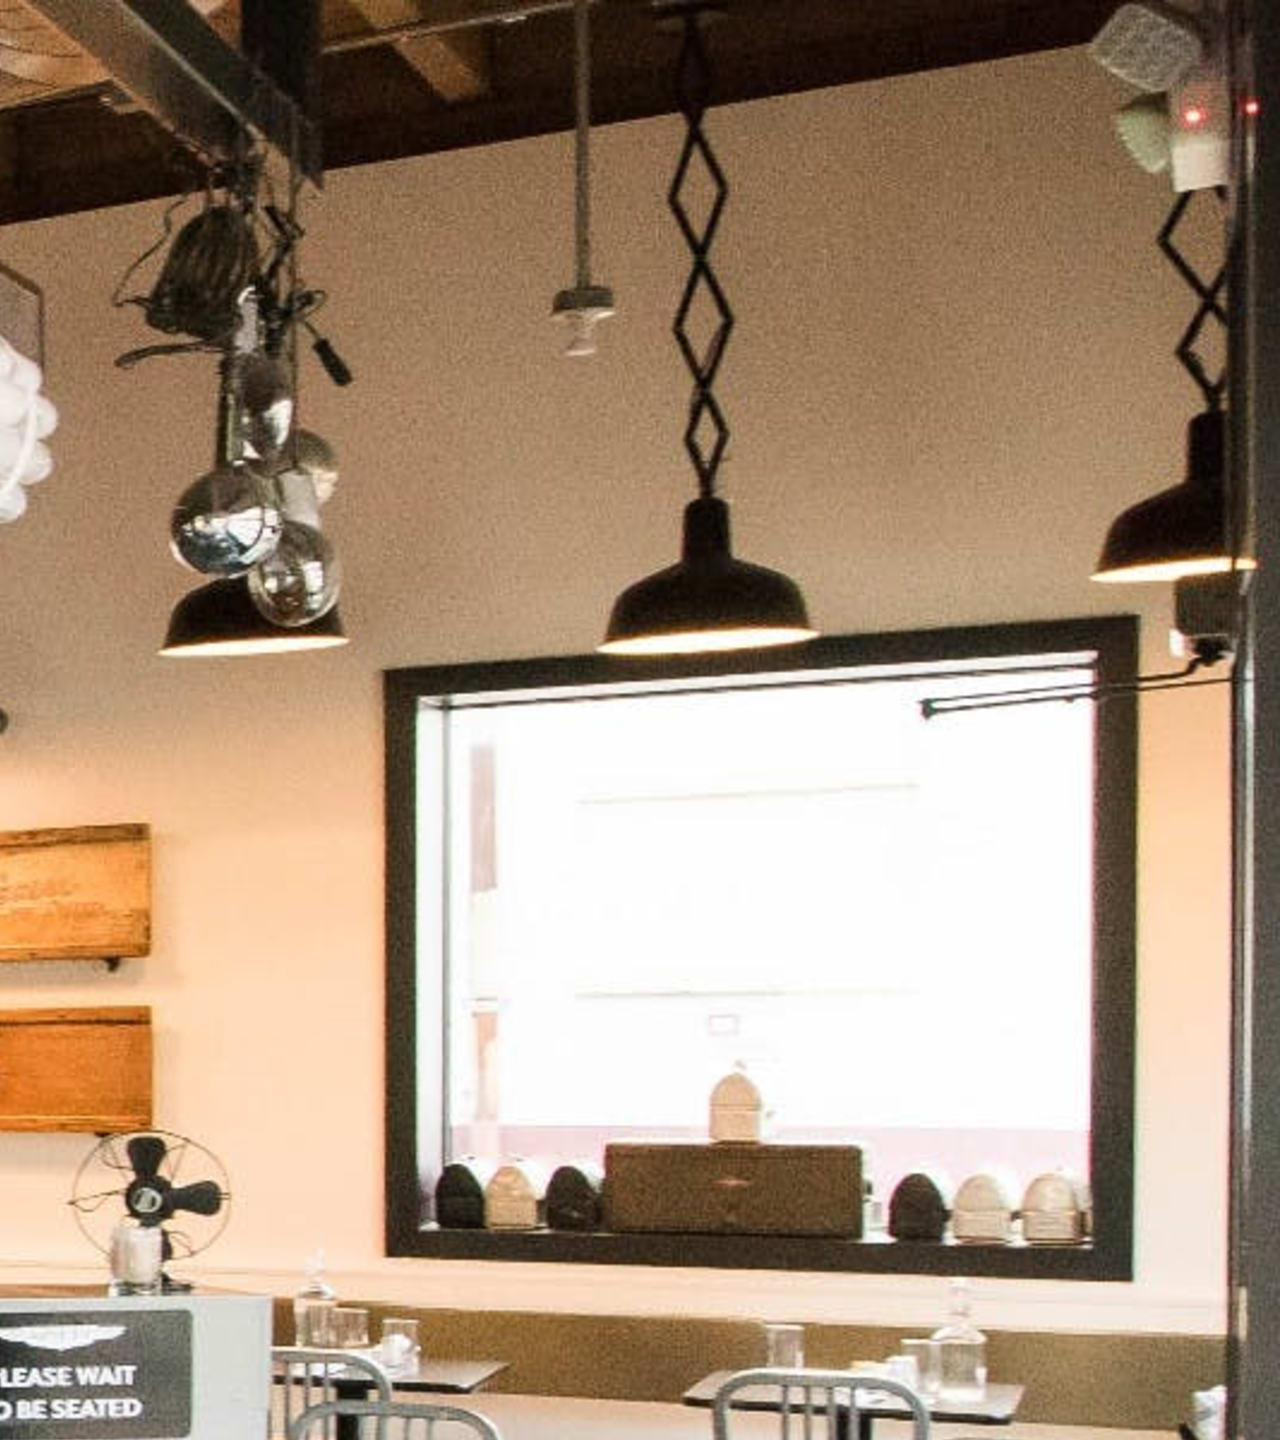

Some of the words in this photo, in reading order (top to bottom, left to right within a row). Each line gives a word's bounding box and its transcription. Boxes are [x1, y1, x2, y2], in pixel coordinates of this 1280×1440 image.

[75, 1364, 138, 1386] WAIT
[16, 1400, 48, 1420] BE
[51, 1399, 143, 1420] SEATED
